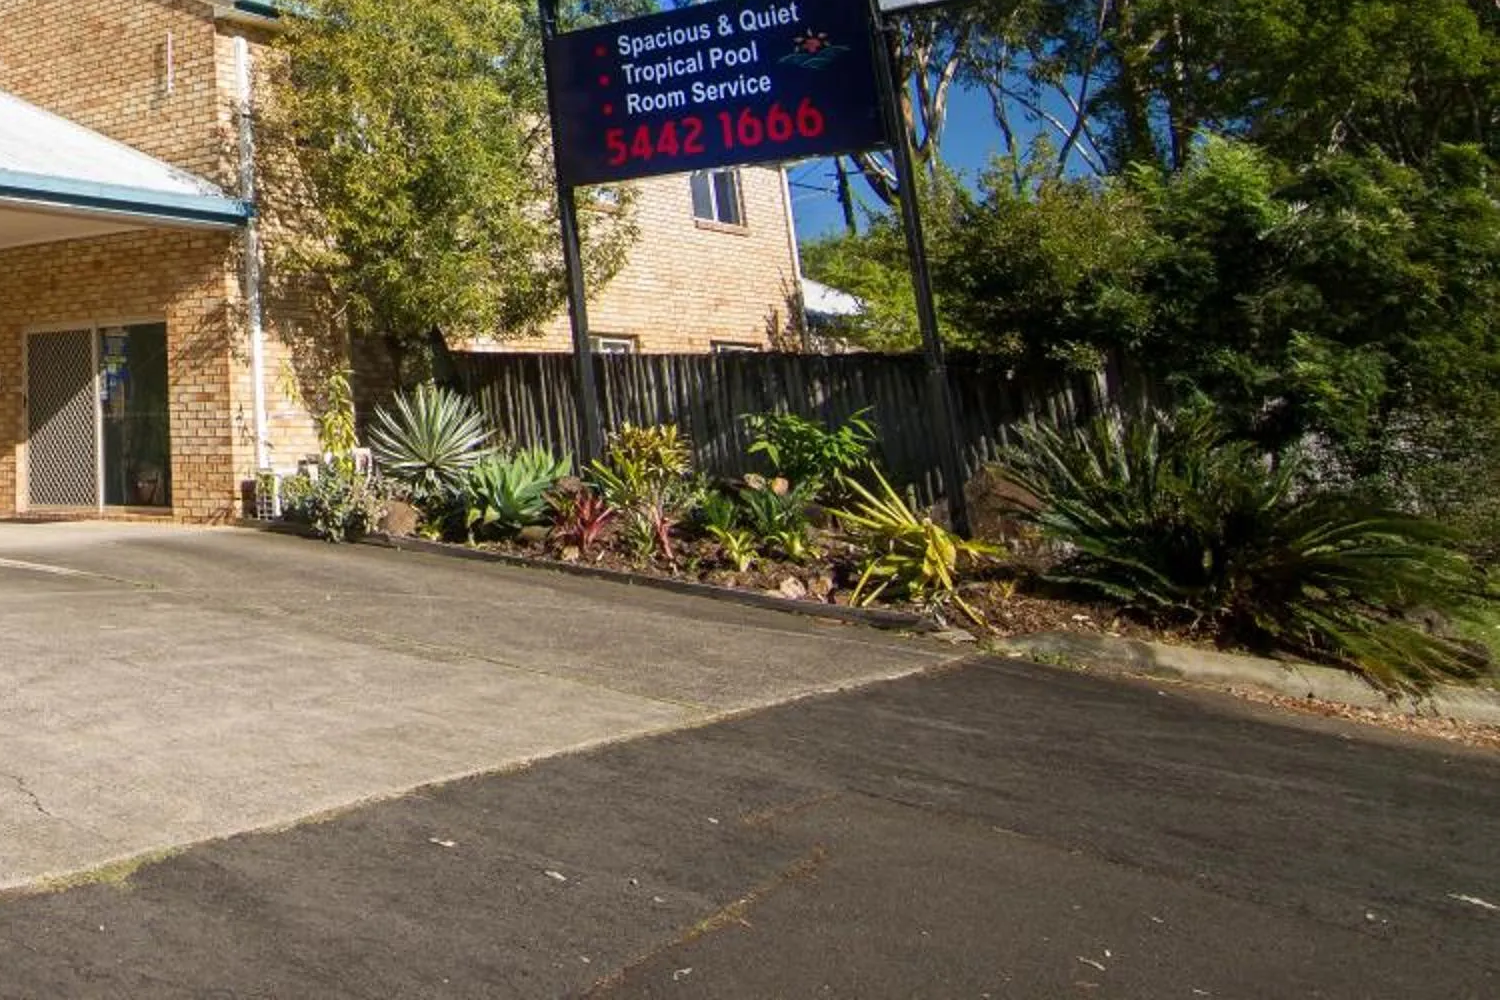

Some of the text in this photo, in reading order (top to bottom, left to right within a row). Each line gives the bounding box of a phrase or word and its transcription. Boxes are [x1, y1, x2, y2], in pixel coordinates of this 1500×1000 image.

[617, 1, 800, 58] Spacious & Quiet
[621, 40, 759, 85] Tropical Pool
[627, 74, 772, 115] Room Service
[605, 97, 825, 166] 5442 1666
